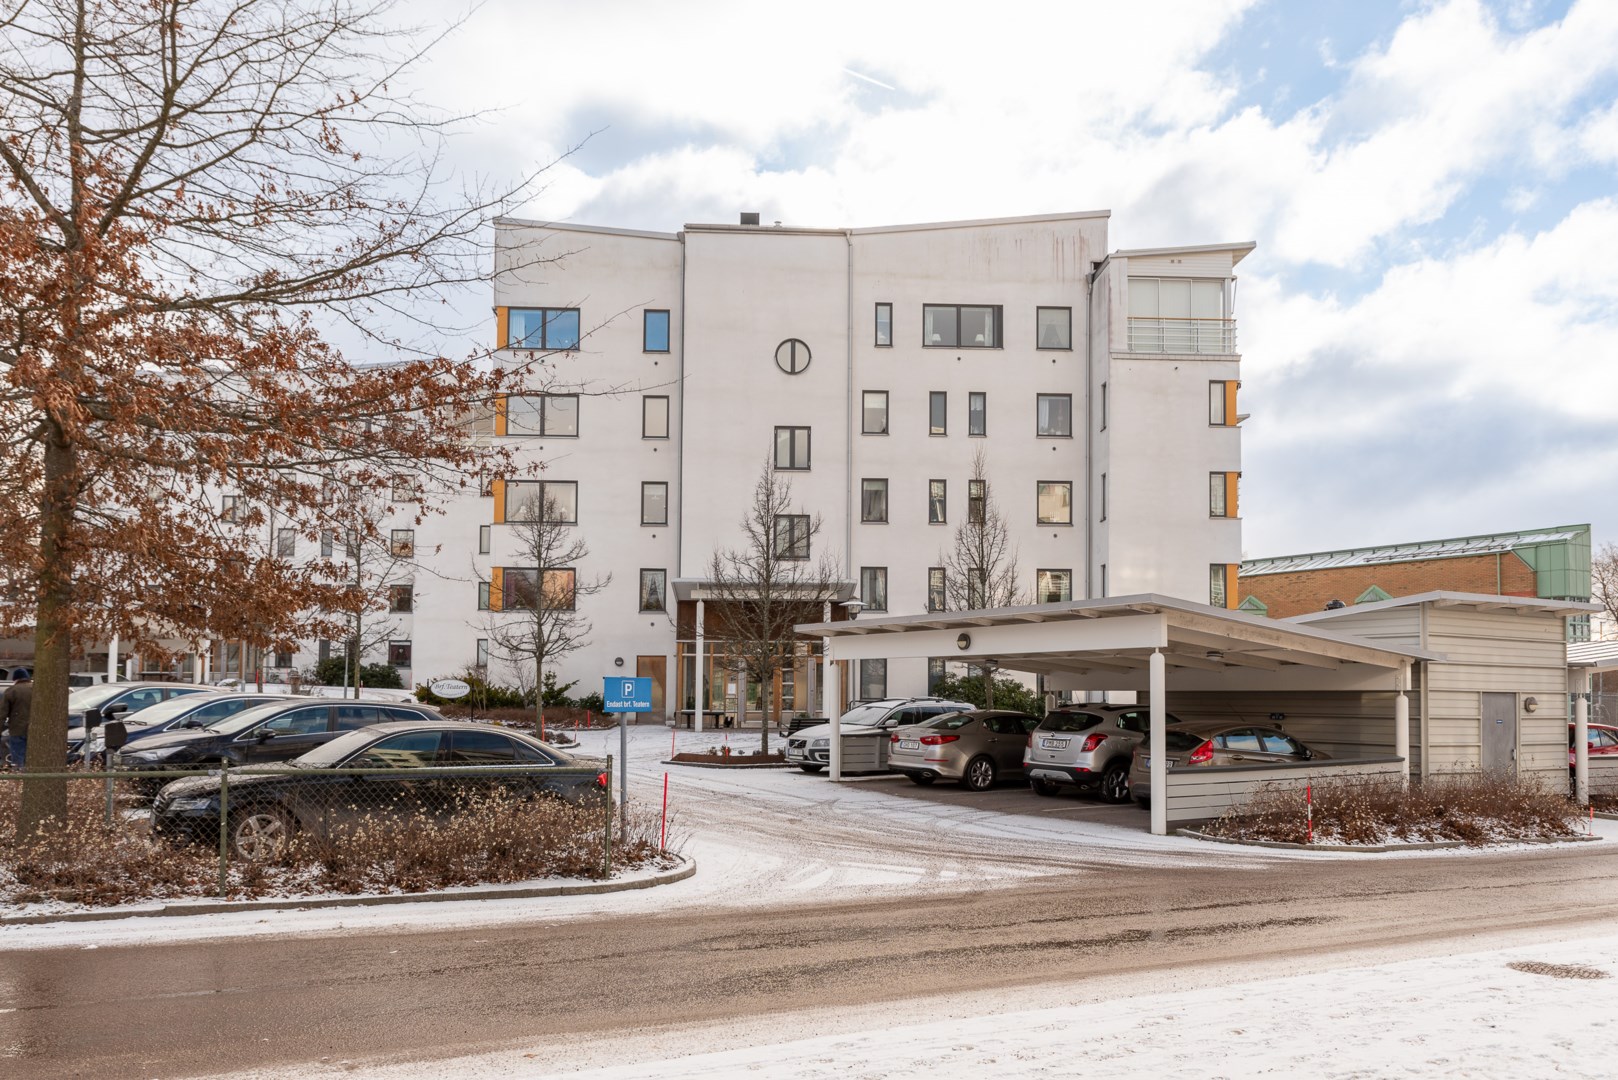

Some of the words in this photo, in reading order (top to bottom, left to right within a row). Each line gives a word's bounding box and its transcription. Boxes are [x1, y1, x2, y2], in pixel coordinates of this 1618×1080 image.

[624, 683, 633, 696] P
[606, 700, 623, 708] Endast
[623, 700, 632, 708] brf.
[632, 700, 650, 708] Teatern
